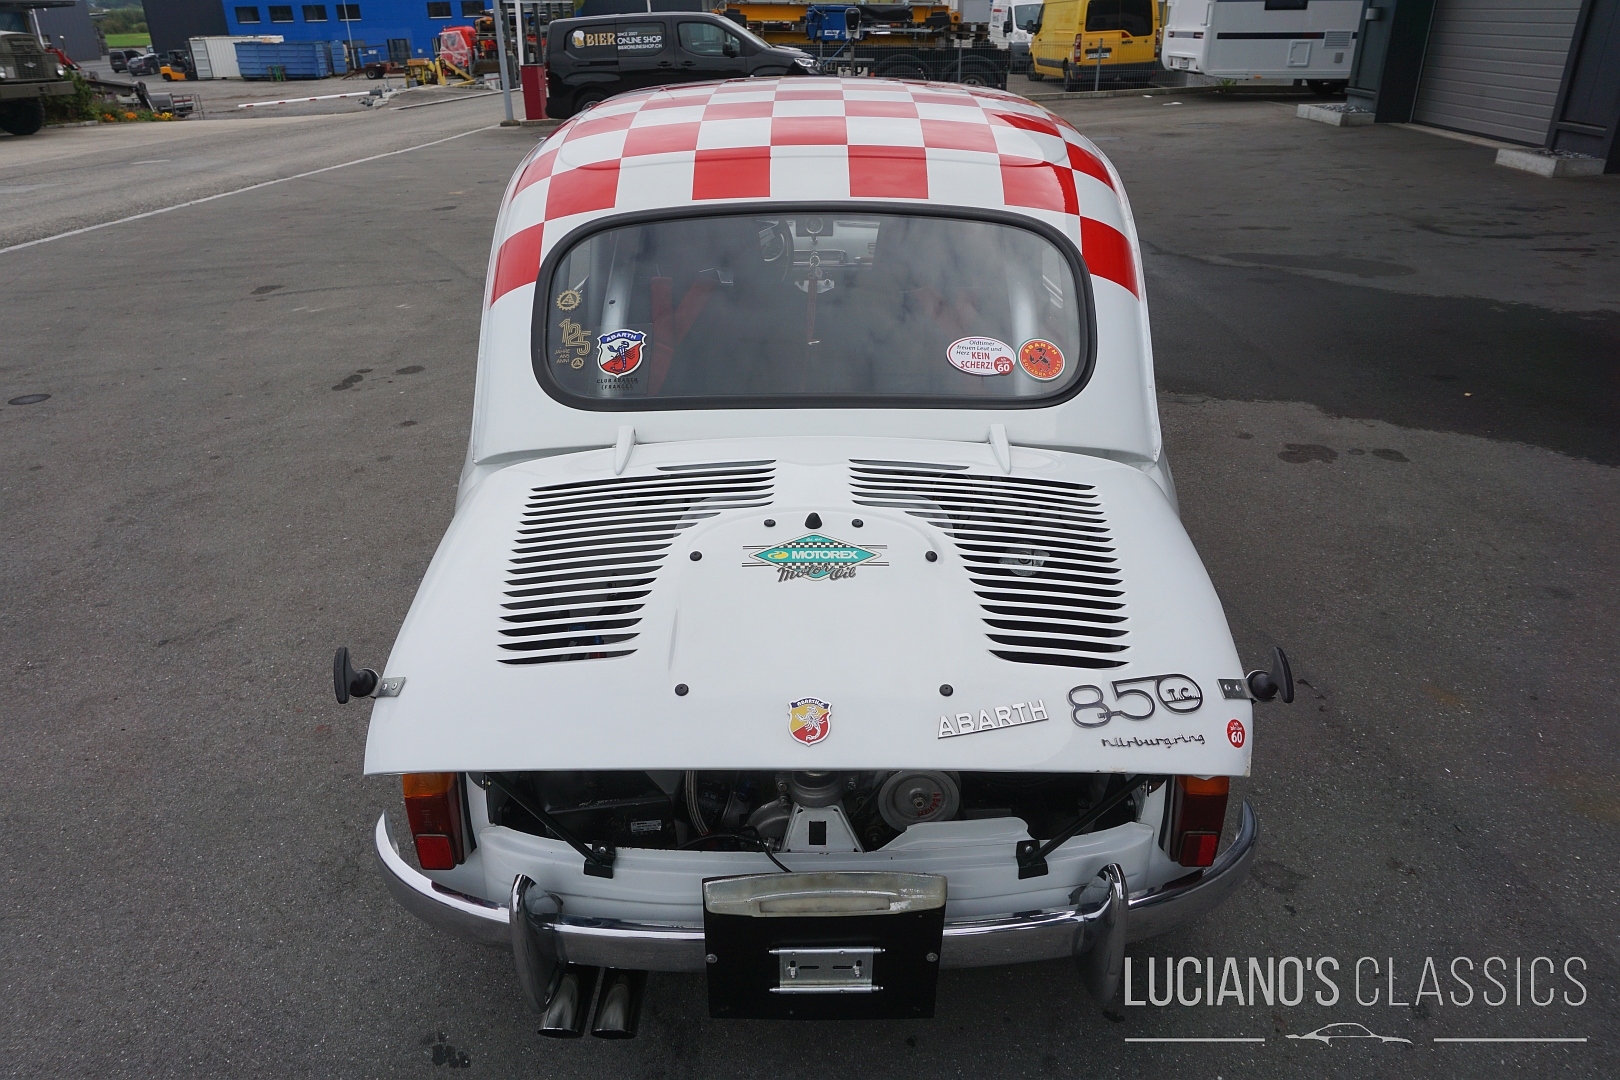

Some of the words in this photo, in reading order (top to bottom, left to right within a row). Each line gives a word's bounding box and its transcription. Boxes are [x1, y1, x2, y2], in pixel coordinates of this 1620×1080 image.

[585, 32, 616, 46] BIER
[617, 36, 642, 45] ONLINE
[643, 35, 662, 43] SHOP
[559, 318, 592, 356] 125
[606, 332, 637, 342] ABARTH
[1024, 342, 1058, 355] ABARTH
[971, 351, 991, 360] KEIN
[997, 364, 1010, 372] 60
[791, 550, 859, 560] MOTOREX
[777, 563, 834, 583] Motor
[829, 566, 857, 581] Oil
[1067, 673, 1204, 728] 850
[937, 699, 1049, 739] ABARTH
[1231, 731, 1243, 743] 60
